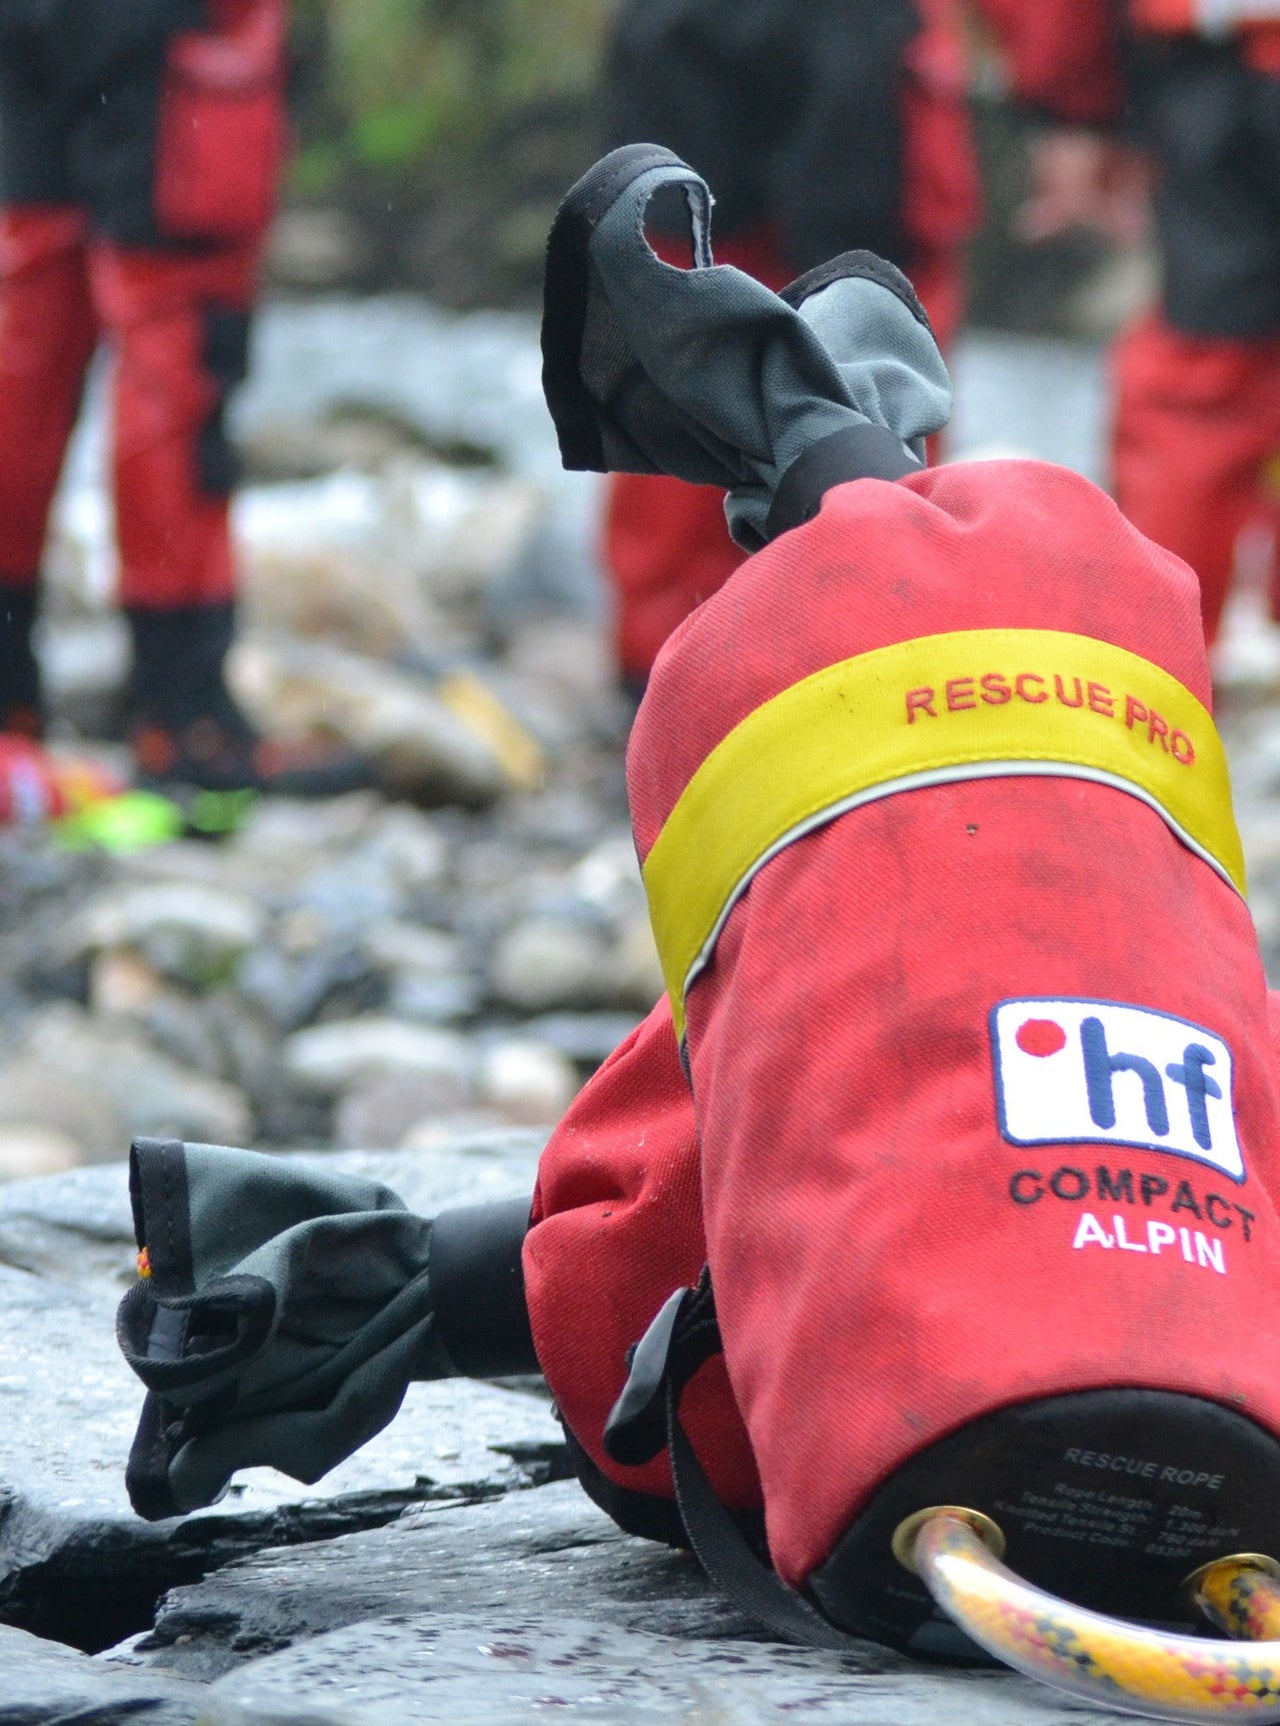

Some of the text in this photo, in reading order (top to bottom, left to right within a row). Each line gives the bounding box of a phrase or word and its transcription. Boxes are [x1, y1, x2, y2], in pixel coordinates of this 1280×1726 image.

[905, 673, 1196, 766] RESCUE PRO
[1080, 1016, 1223, 1151] hf
[1009, 1165, 1256, 1242] COMPACT
[1073, 1212, 1227, 1274] ALPIN
[1062, 1447, 1225, 1490] RESCUE ROPE
